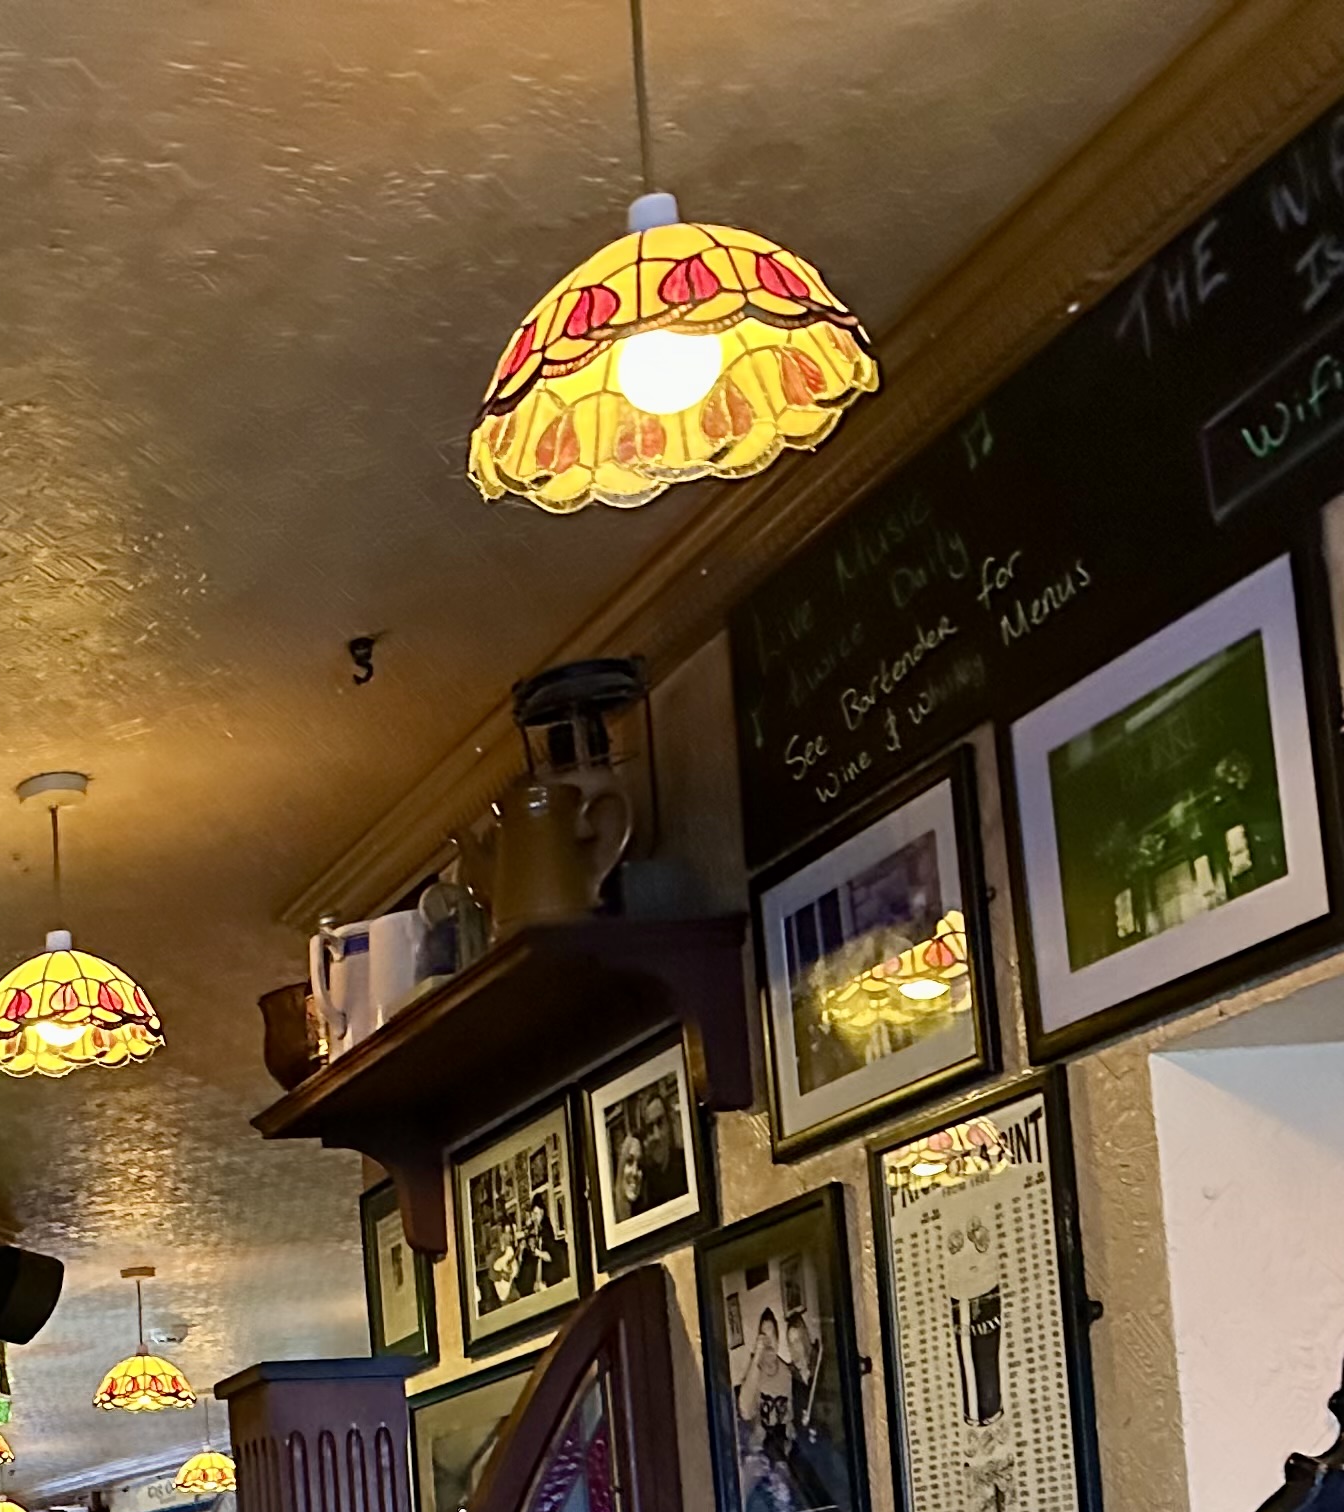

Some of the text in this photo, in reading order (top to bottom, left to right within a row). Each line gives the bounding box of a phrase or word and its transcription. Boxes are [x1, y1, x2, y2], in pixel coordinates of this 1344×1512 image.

[785, 733, 831, 781] See
[977, 549, 1023, 610] for
[999, 558, 1094, 646] Menus
